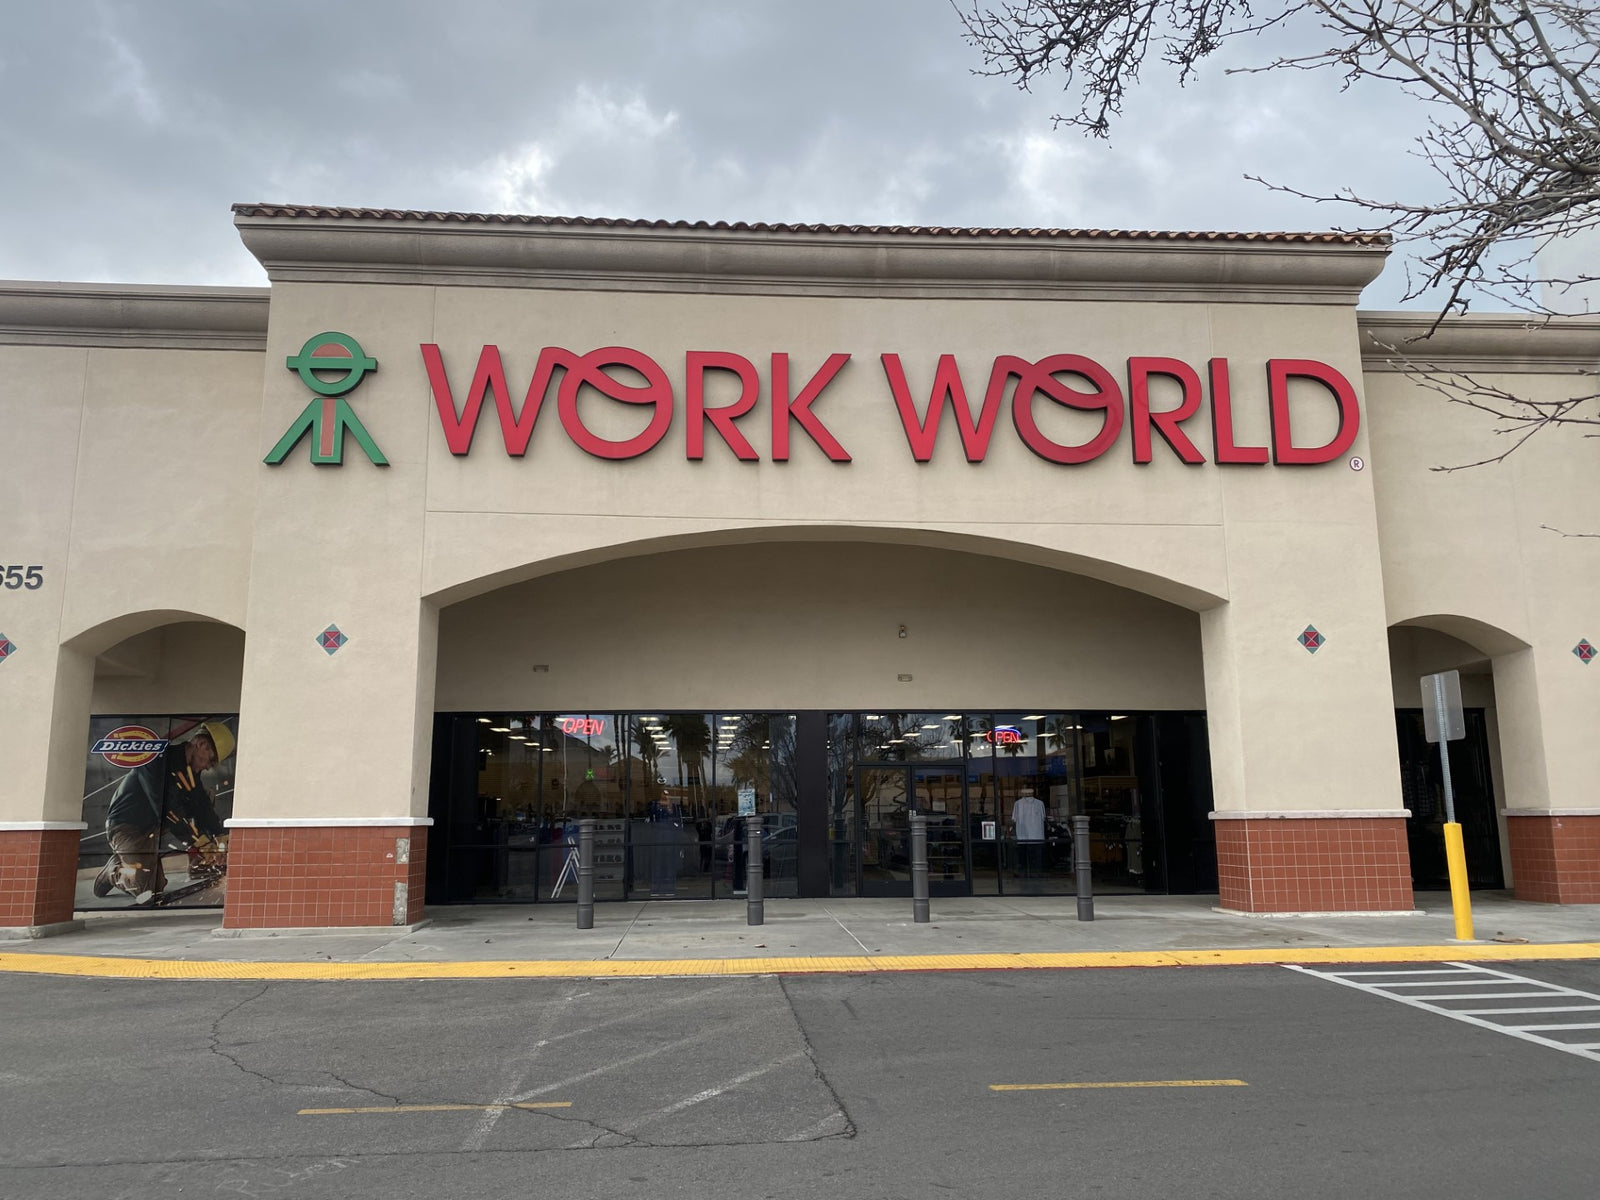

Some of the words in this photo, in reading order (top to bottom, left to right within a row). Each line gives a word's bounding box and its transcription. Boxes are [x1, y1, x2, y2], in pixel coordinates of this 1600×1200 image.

[421, 343, 852, 462] WORK
[882, 352, 1361, 466] WORLD
[561, 717, 604, 735] OPEN
[99, 741, 162, 751] Dickies
